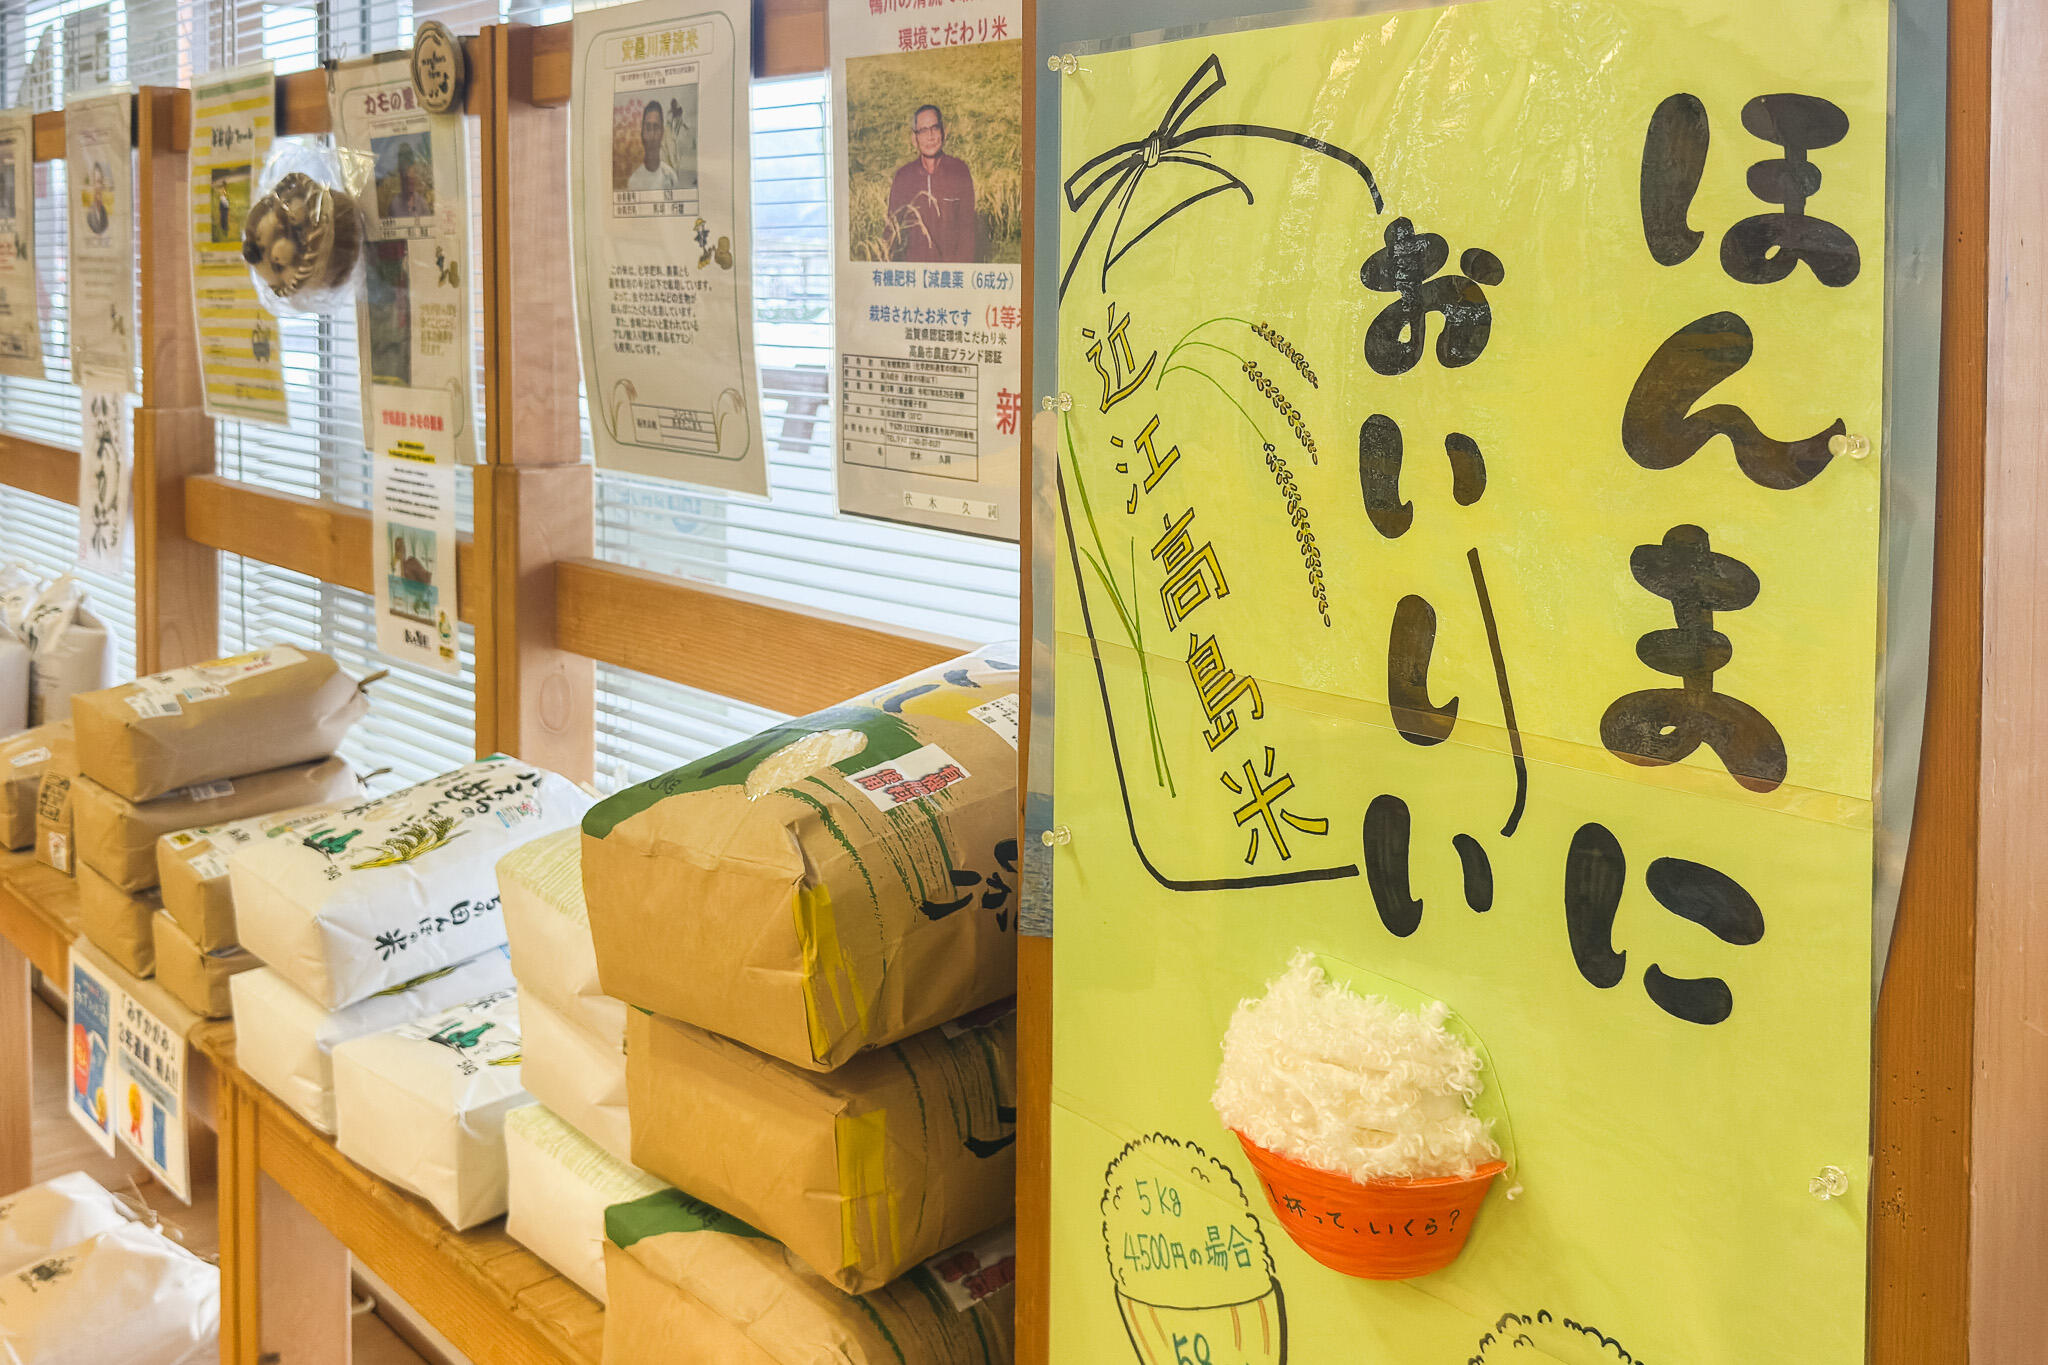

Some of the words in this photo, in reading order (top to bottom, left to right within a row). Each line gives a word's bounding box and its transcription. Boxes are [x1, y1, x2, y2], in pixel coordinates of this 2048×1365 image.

[898, 15, 1008, 51] 環境こだわり米
[868, 305, 972, 327] 栽培されたお米です
[1081, 302, 1330, 866] 近江高島米
[1360, 215, 1505, 938] おいしい
[1564, 92, 1861, 1025] ほんまに
